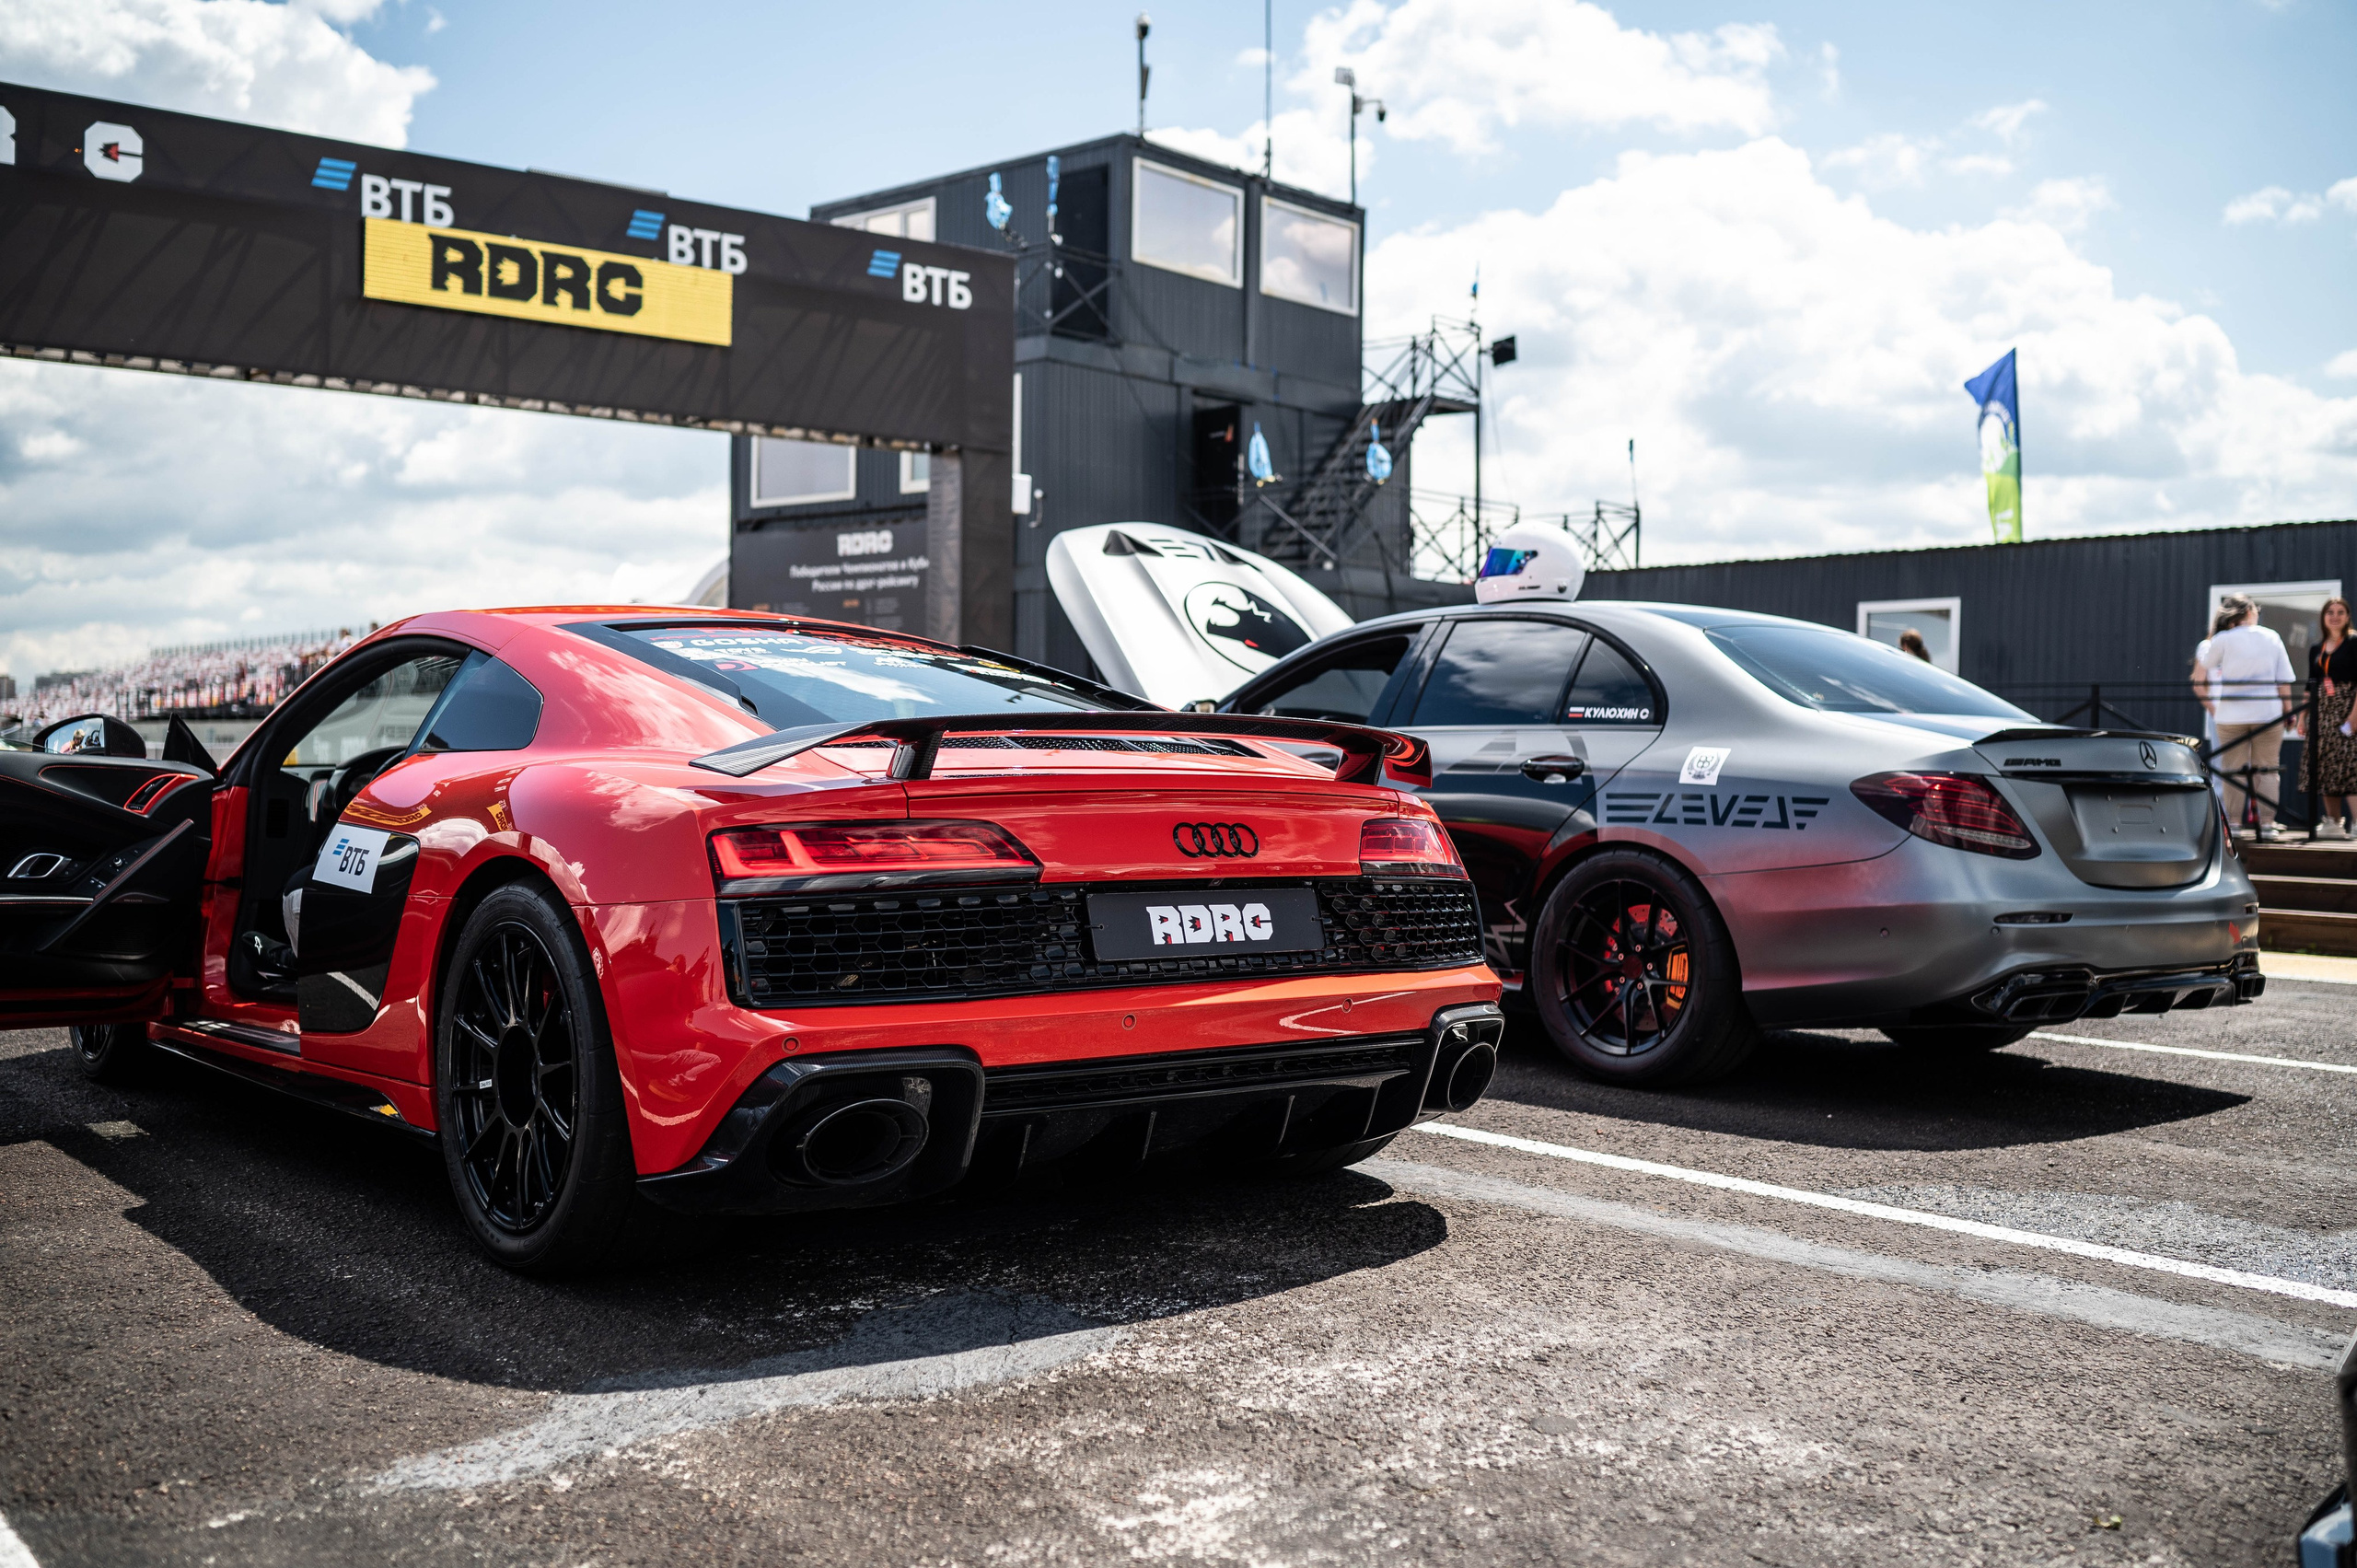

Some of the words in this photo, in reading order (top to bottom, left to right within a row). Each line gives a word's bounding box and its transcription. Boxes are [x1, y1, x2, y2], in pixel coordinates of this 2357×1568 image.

[361, 173, 455, 228] ВТБ
[668, 224, 749, 275] ВТБ
[428, 233, 644, 318] RDRC
[902, 263, 973, 310] ВТБ
[1584, 706, 1639, 719] КУЛЮХИН
[339, 846, 370, 877] ВТБ
[1145, 902, 1274, 946] RDRC
